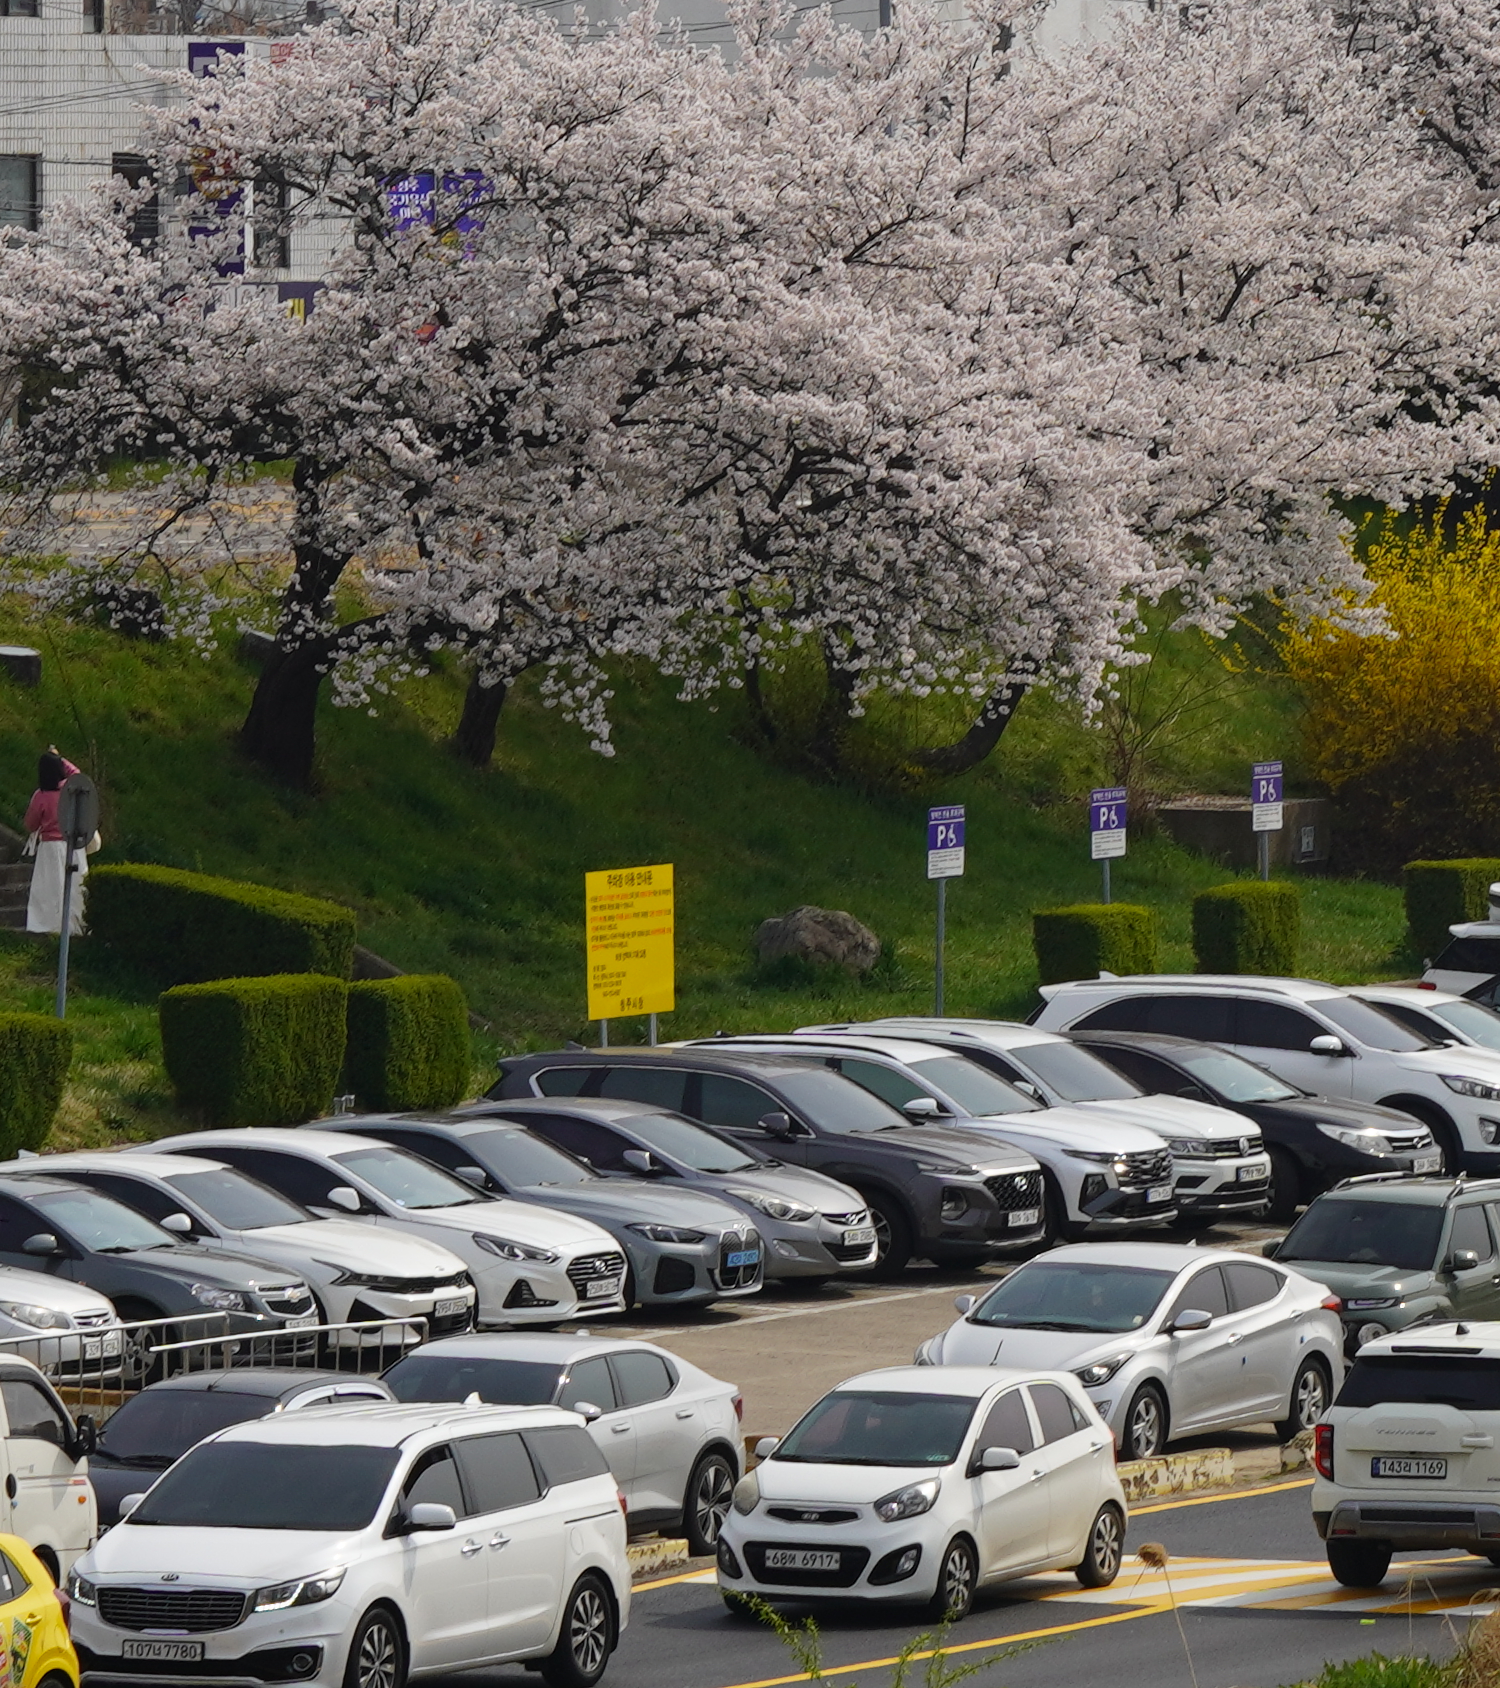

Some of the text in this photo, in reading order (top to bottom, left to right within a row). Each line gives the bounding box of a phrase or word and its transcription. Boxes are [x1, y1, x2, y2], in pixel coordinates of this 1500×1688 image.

[1260, 780, 1268, 801] P
[1100, 807, 1108, 828] P
[938, 826, 946, 847] P
[1415, 1461, 1443, 1475] 1169
[801, 1553, 833, 1568] 6917
[164, 1645, 197, 1659] 7780
